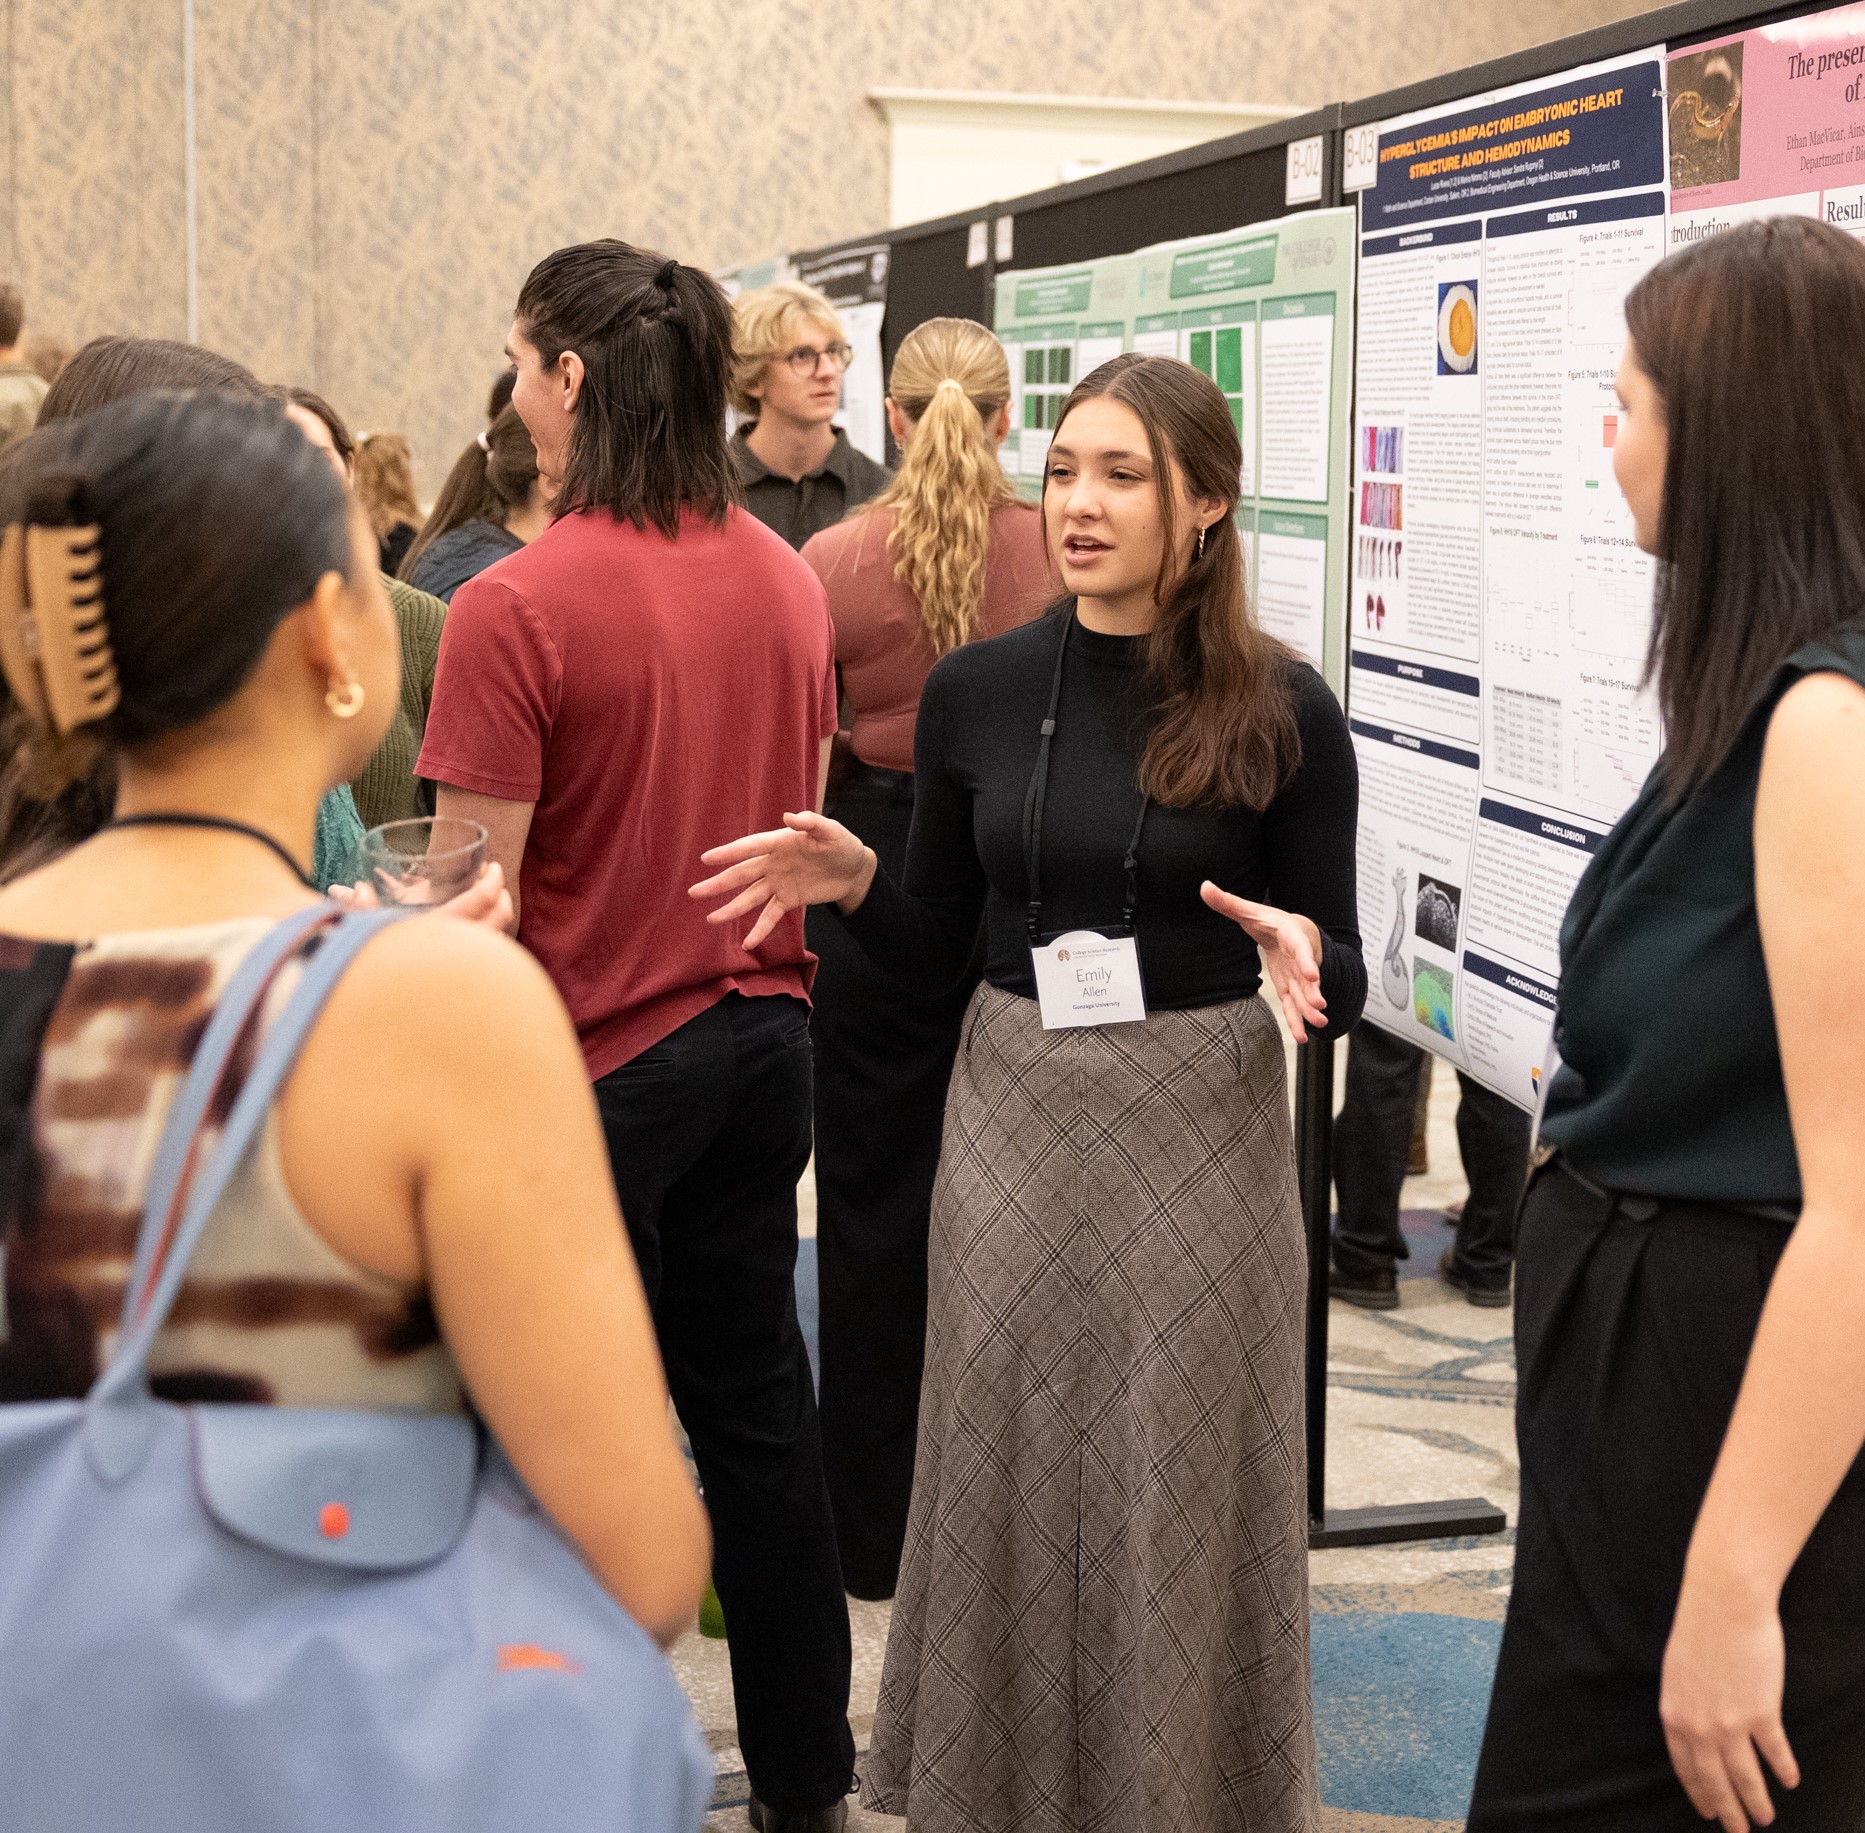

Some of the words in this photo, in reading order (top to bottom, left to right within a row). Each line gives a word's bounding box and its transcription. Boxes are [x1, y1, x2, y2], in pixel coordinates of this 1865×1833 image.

[1787, 52, 1814, 80] The
[1845, 73, 1862, 103] of
[1458, 120, 1499, 143] IMPACT
[1499, 115, 1514, 134] ON
[1514, 99, 1579, 130] EMBRYONIC
[1579, 88, 1624, 114] HEART
[1346, 129, 1375, 168] B-03
[1786, 133, 1808, 150] Ethan
[1809, 127, 1846, 147] MacVicar,
[1293, 142, 1320, 179] B-02
[1409, 154, 1461, 180] STRUCTURE
[1461, 149, 1485, 169] AND
[1485, 128, 1570, 164] HEMODYNAMICS
[1800, 149, 1844, 173] Department
[1845, 146, 1854, 163] of
[1855, 145, 1865, 161] Bi
[1553, 169, 1568, 180] Science
[1569, 165, 1592, 177] University,
[1592, 162, 1612, 173] Portland,
[1612, 160, 1620, 170] OR
[1547, 209, 1578, 223] RESULTS
[1579, 234, 1594, 245] Figure
[1600, 231, 1612, 240] Trials
[1624, 227, 1644, 238] Survival
[1568, 370, 1581, 381] Figure
[1586, 369, 1599, 379] Trials
[1580, 534, 1593, 545] Figure
[1598, 535, 1610, 545] Trials
[1541, 821, 1586, 844] CONCLUSION
[1075, 966, 1112, 984] Emily
[1082, 987, 1107, 998] Allen
[1095, 1001, 1120, 1009] University
